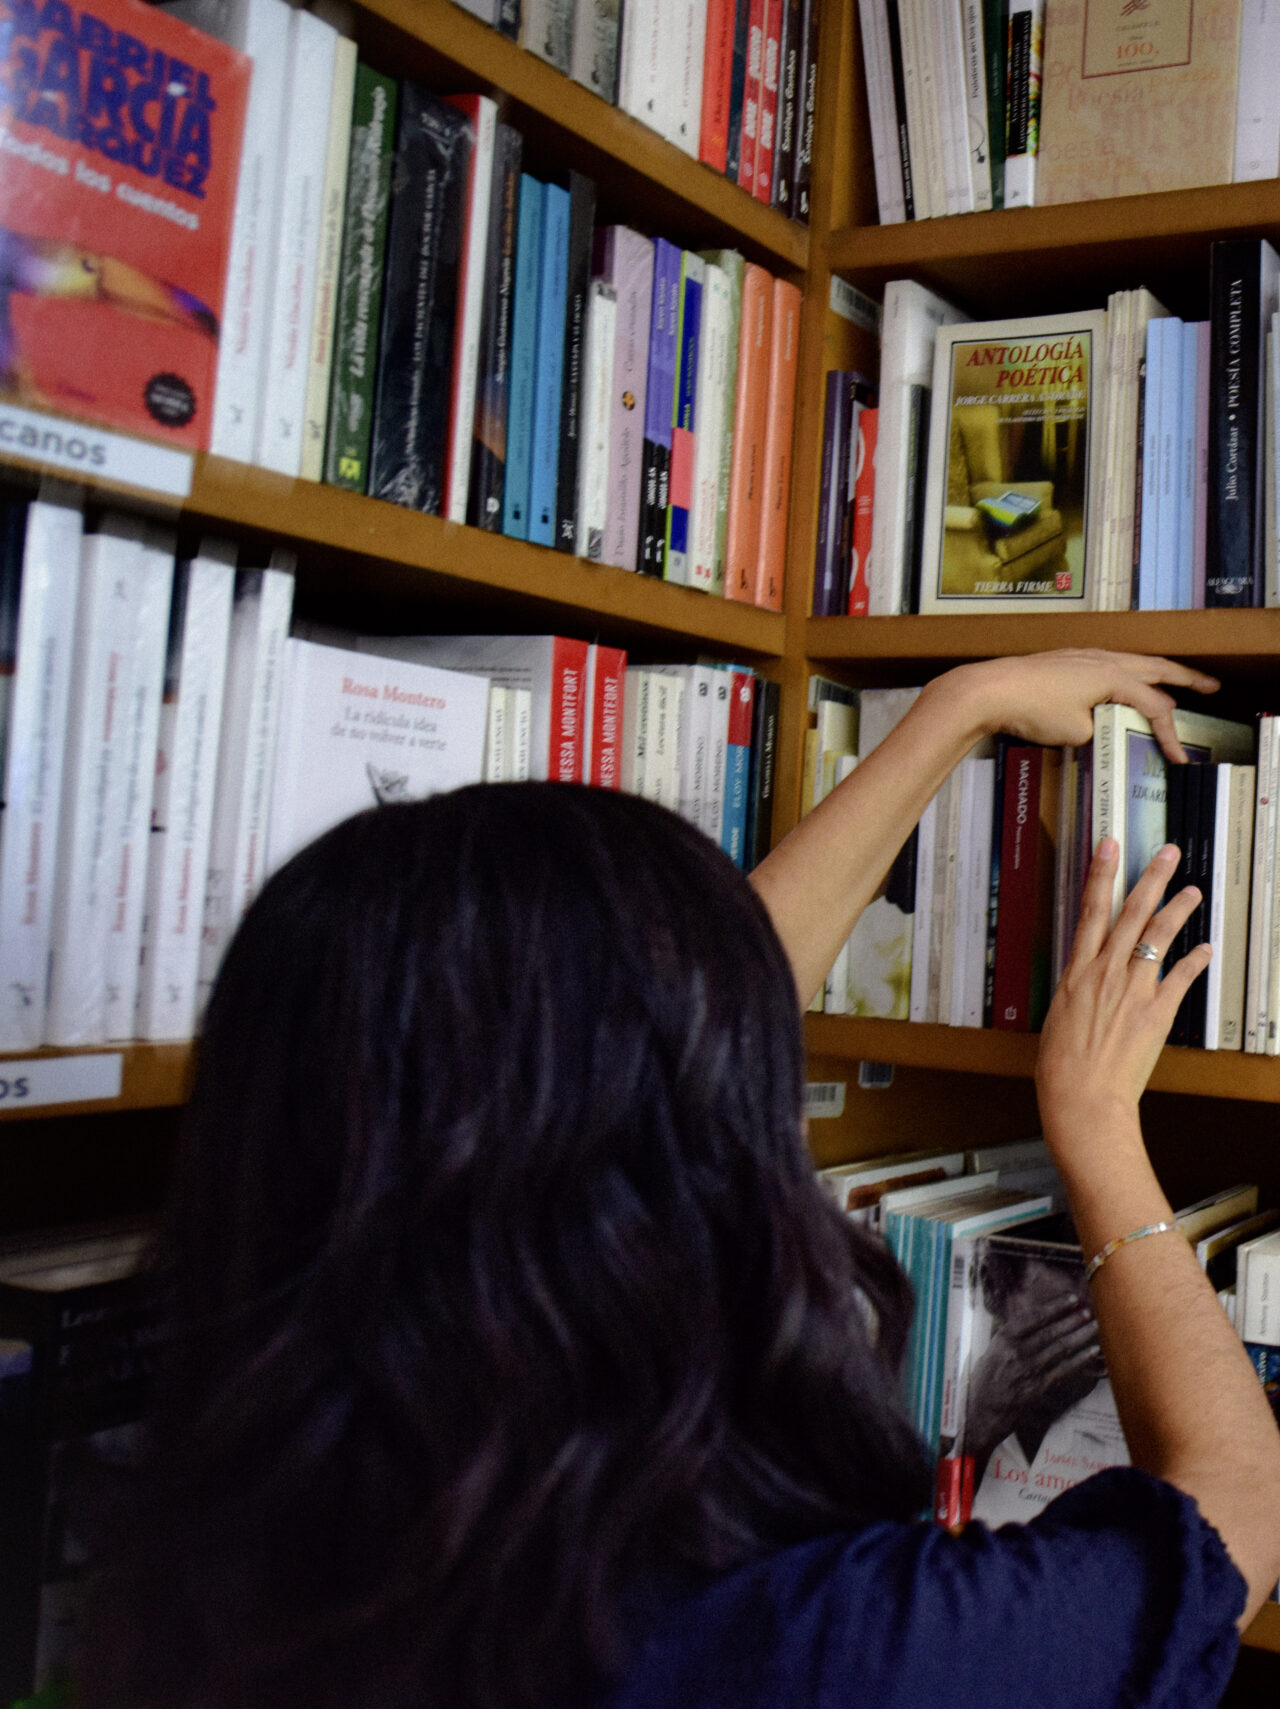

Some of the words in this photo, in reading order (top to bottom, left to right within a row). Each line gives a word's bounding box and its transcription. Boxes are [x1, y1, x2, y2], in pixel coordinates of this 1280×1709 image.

[74, 160, 112, 194] los
[116, 182, 200, 232] cuentos
[1228, 279, 1243, 354] COMPLETA
[966, 336, 1084, 367] ANTOLOGÍA
[996, 364, 1083, 387] POÉTICA
[1225, 358, 1242, 408] POESÍA
[1225, 426, 1240, 473] Cortázar
[1225, 475, 1239, 501] Julio
[974, 580, 1014, 594] TIERRA
[1016, 578, 1054, 593] FIRME
[342, 677, 380, 700] Rosa
[383, 684, 446, 710] Montero
[561, 667, 578, 736] MONTFORT
[603, 676, 618, 743] MONTFORT
[330, 722, 345, 738] de
[347, 727, 361, 738] no
[364, 727, 402, 746] volver
[416, 735, 447, 752] verte
[343, 706, 359, 721] La
[410, 715, 437, 734] idea
[693, 736, 706, 791] MORENO
[711, 738, 723, 793] MORENO
[1099, 725, 1111, 773] MANTO
[1016, 759, 1031, 823] MACHADO
[994, 1458, 1029, 1484] Los
